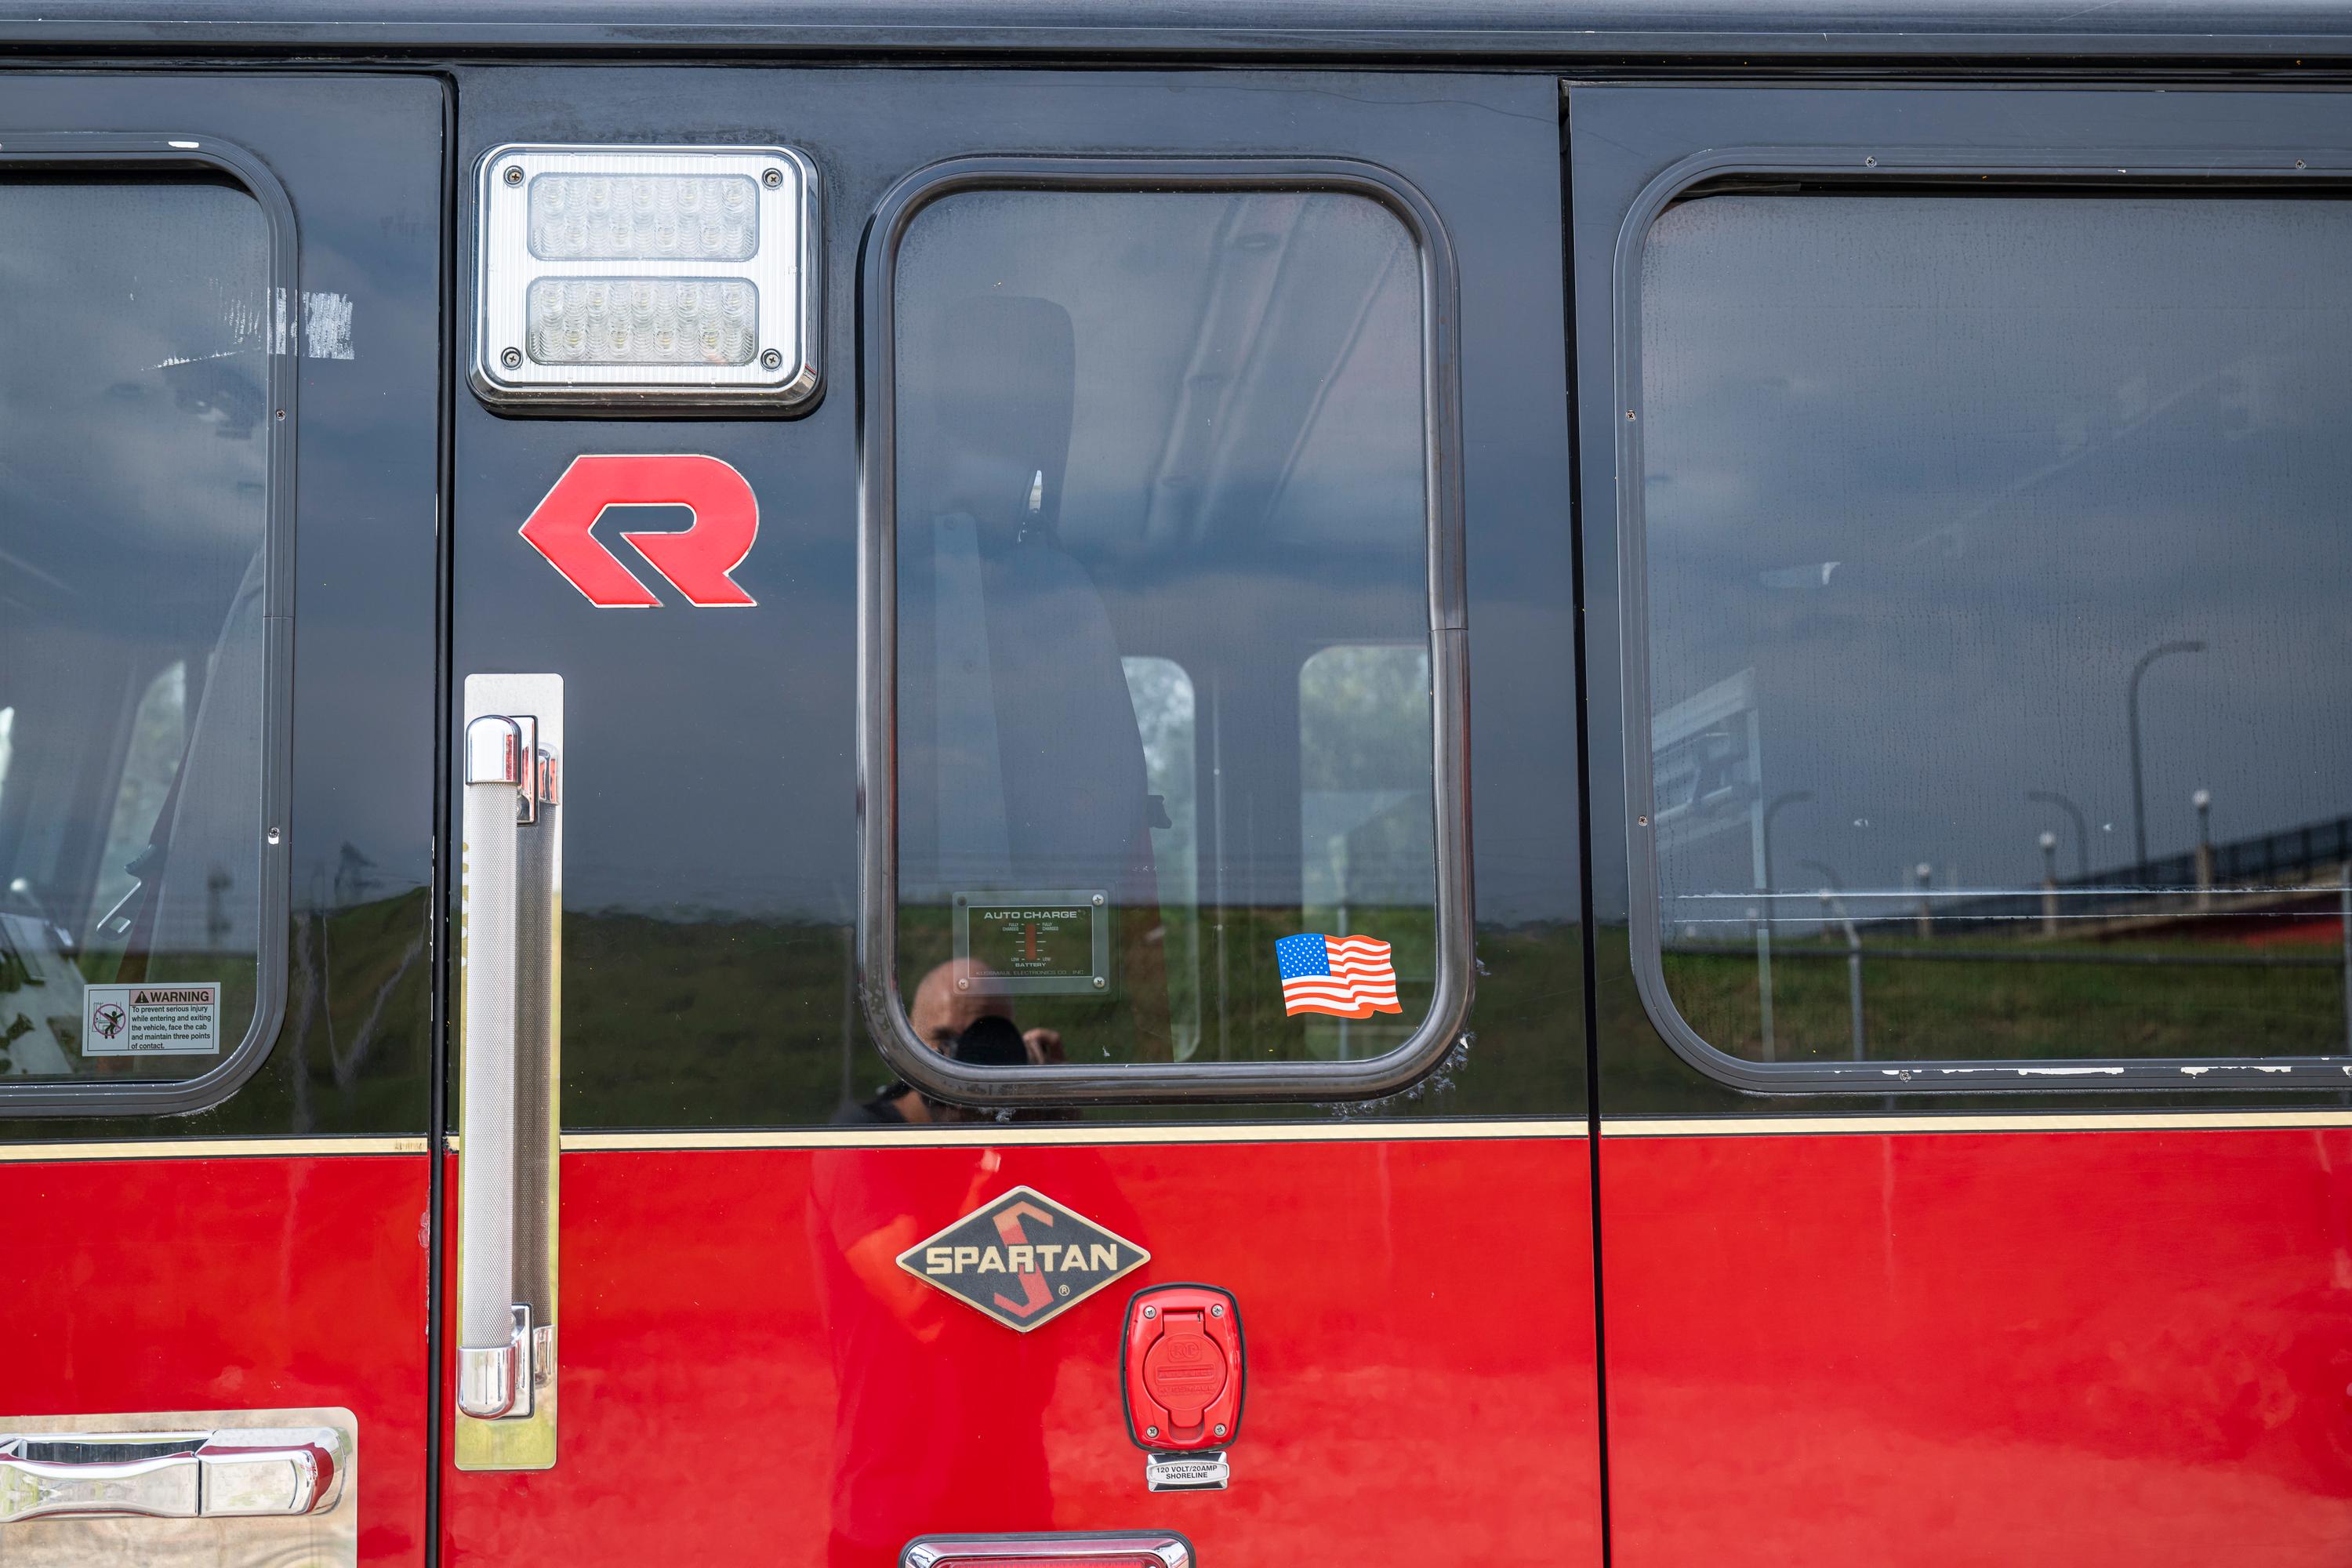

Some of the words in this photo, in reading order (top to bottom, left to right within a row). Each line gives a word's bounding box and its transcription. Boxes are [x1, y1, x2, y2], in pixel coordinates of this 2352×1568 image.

[151, 991, 209, 1002] WARNING
[141, 1005, 165, 1014] prevent
[190, 1005, 209, 1014] injury
[191, 1033, 211, 1041] points
[927, 1243, 1118, 1275] SPARTAN
[1171, 1465, 1218, 1473] VOLT/20AMP
